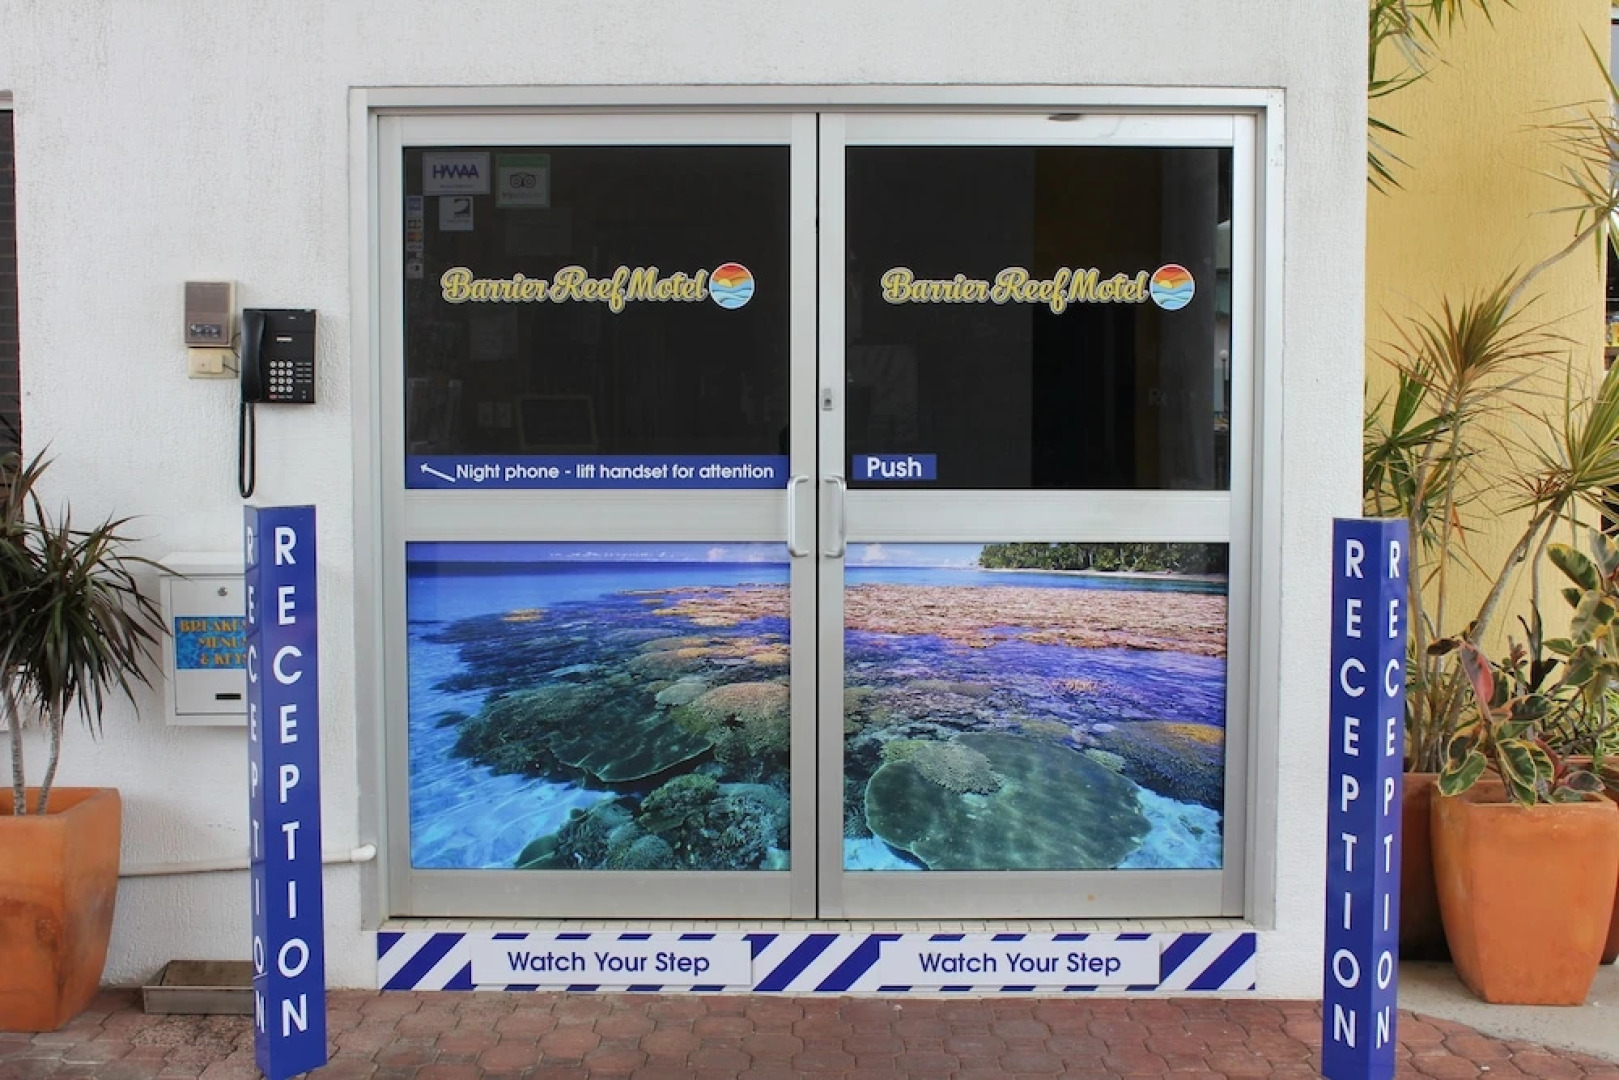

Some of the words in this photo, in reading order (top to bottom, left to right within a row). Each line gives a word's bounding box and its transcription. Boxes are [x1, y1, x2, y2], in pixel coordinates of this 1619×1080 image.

[441, 267, 549, 304] Barrier
[549, 266, 630, 314] Reef
[629, 266, 709, 302] Motel
[881, 267, 990, 304] Barrier
[990, 267, 1071, 314] Reef
[1070, 268, 1150, 303] Motel
[456, 464, 500, 481] Night
[505, 464, 560, 481] phone
[576, 464, 595, 479] lift
[600, 464, 668, 479] handset
[672, 464, 694, 479] for
[699, 464, 774, 479] attention
[867, 457, 922, 477] Push
[247, 526, 265, 1033] RECEPTION
[273, 526, 310, 1037] RECEPTION
[1332, 539, 1366, 1048] RECEPTION
[1376, 540, 1401, 1049] RECEPTION
[507, 951, 585, 973] Watch
[594, 951, 648, 973] Your
[655, 951, 710, 977] Step
[919, 952, 997, 974] Watch
[1006, 952, 1060, 974] Your
[1067, 951, 1122, 977] Step
